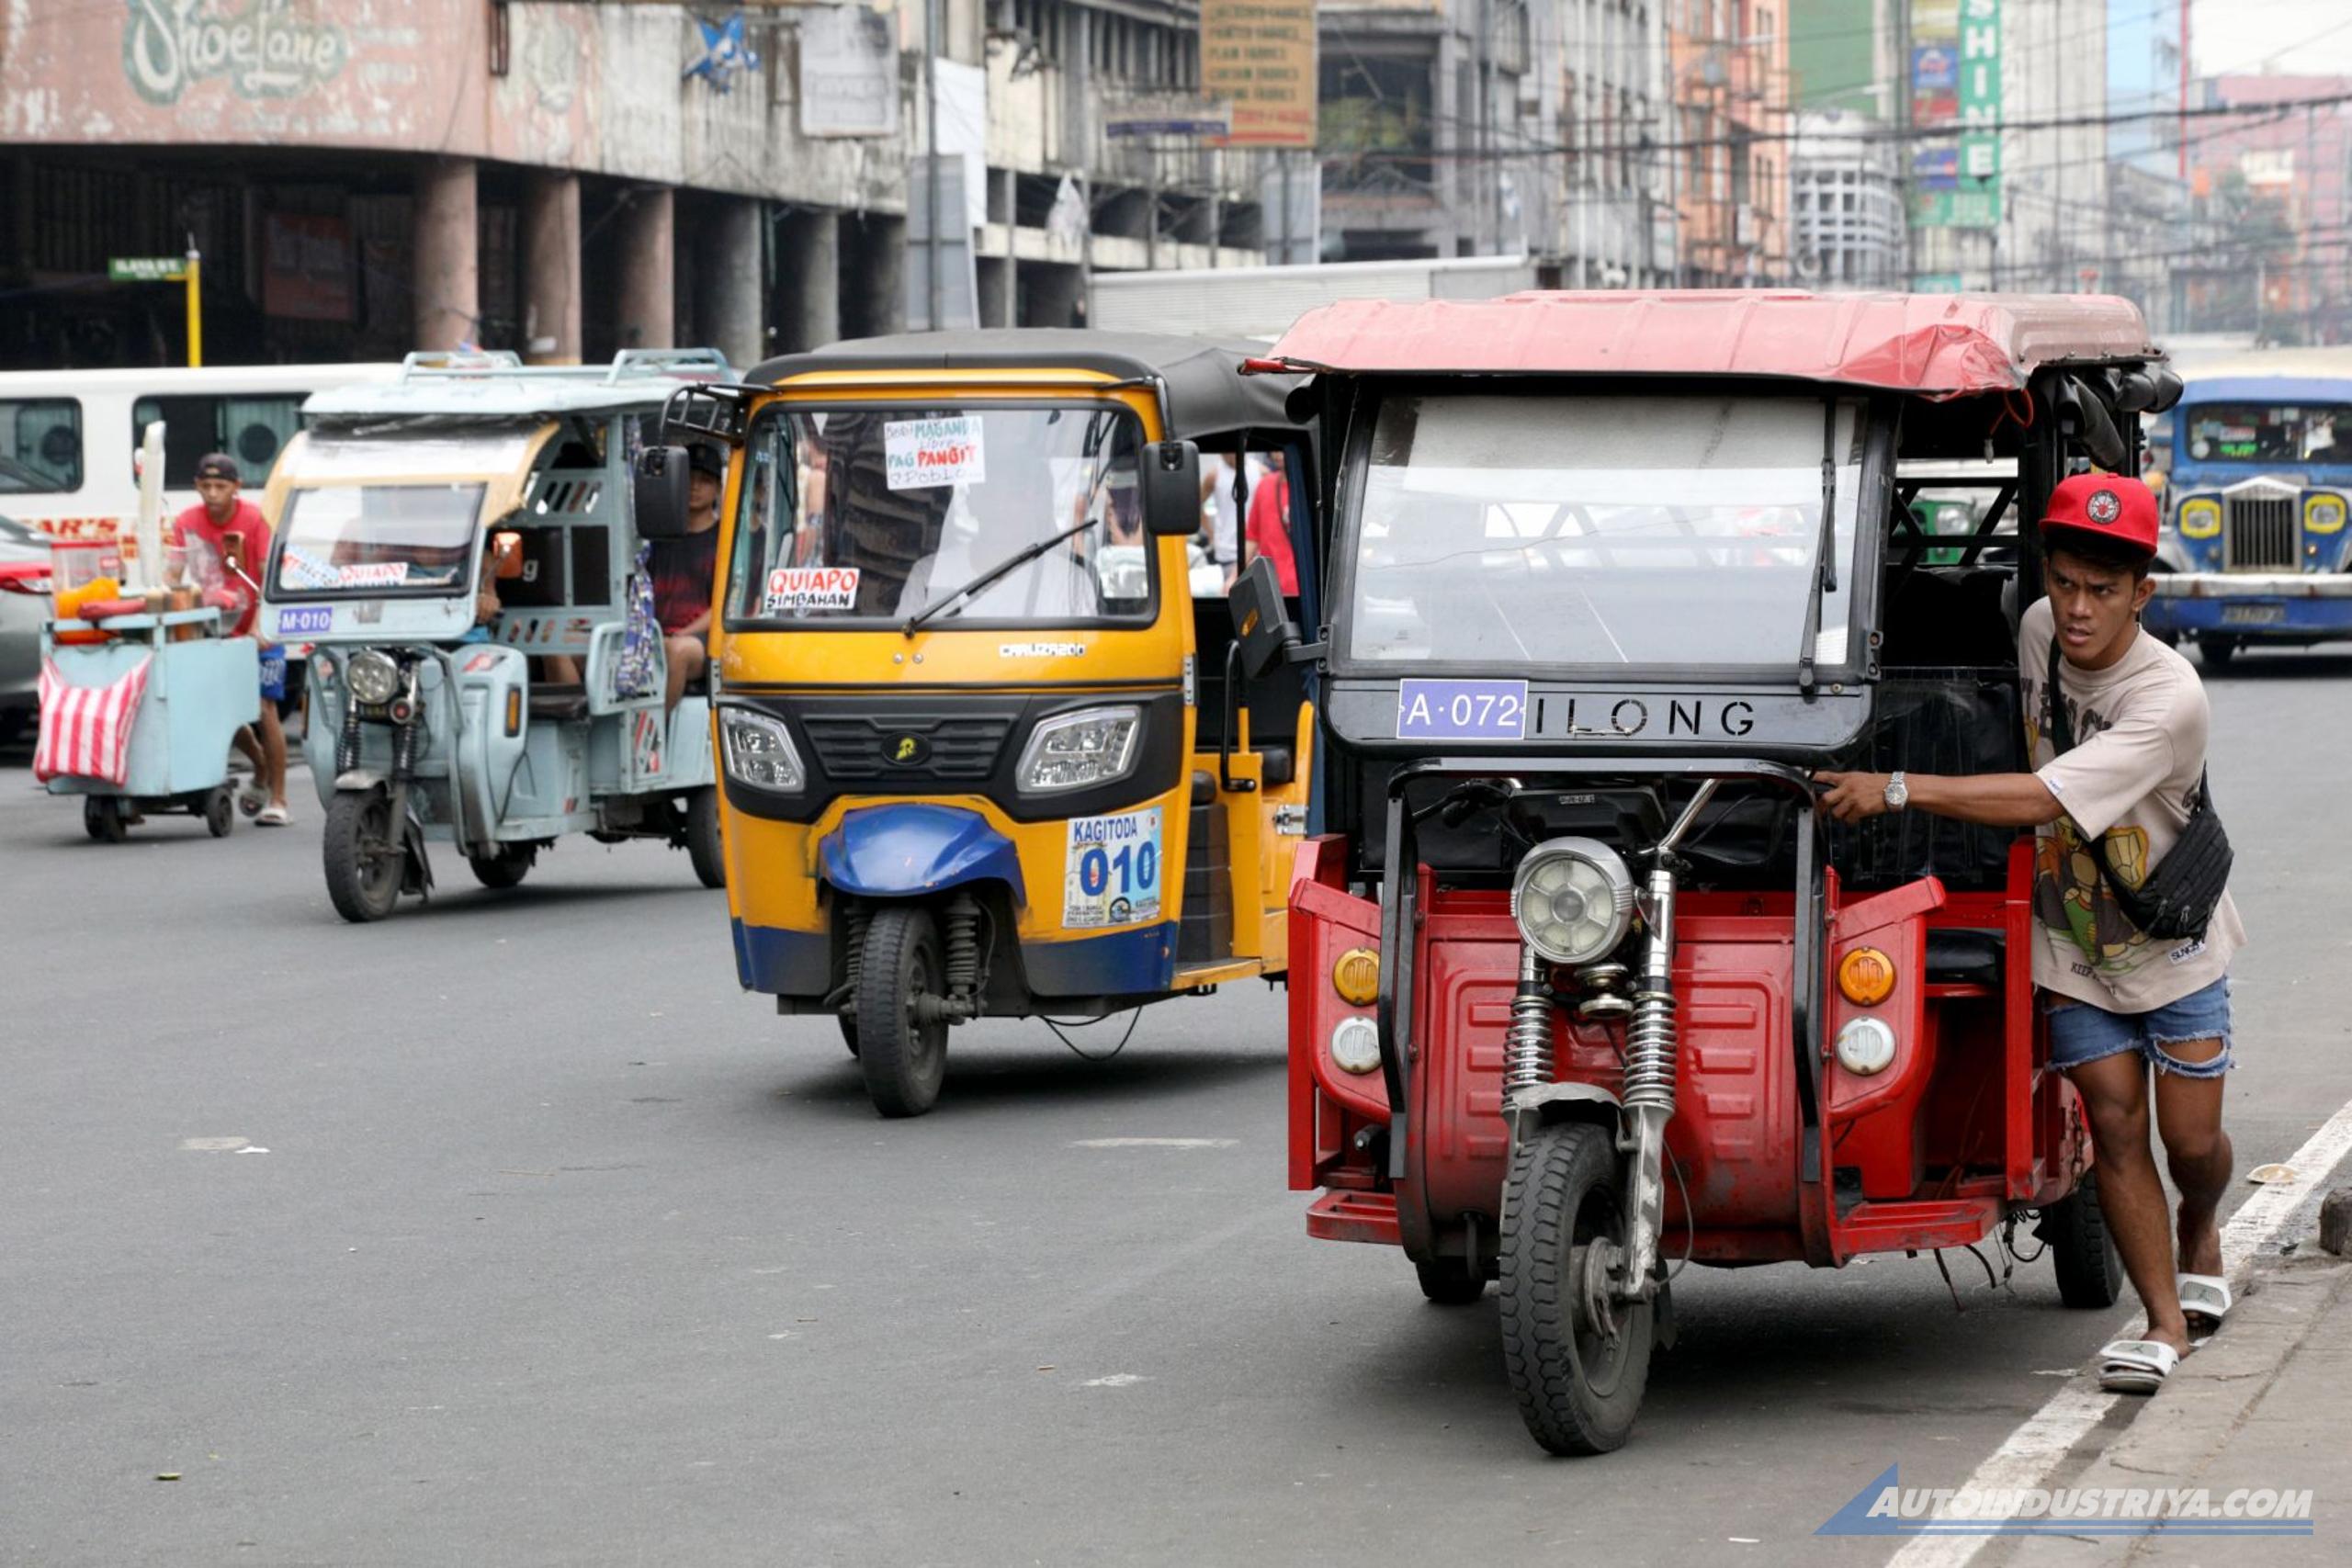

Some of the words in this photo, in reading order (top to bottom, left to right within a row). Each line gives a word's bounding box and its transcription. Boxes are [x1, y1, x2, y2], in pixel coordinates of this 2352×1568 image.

[915, 419, 981, 438] MAGANDA
[888, 452, 915, 468] PAG
[917, 446, 977, 468] PANGIT
[769, 569, 856, 594] QUIAPO
[767, 592, 850, 607] SIMBAHAN
[1074, 815, 1138, 842] KAGITODA
[1080, 840, 1156, 897] 010
